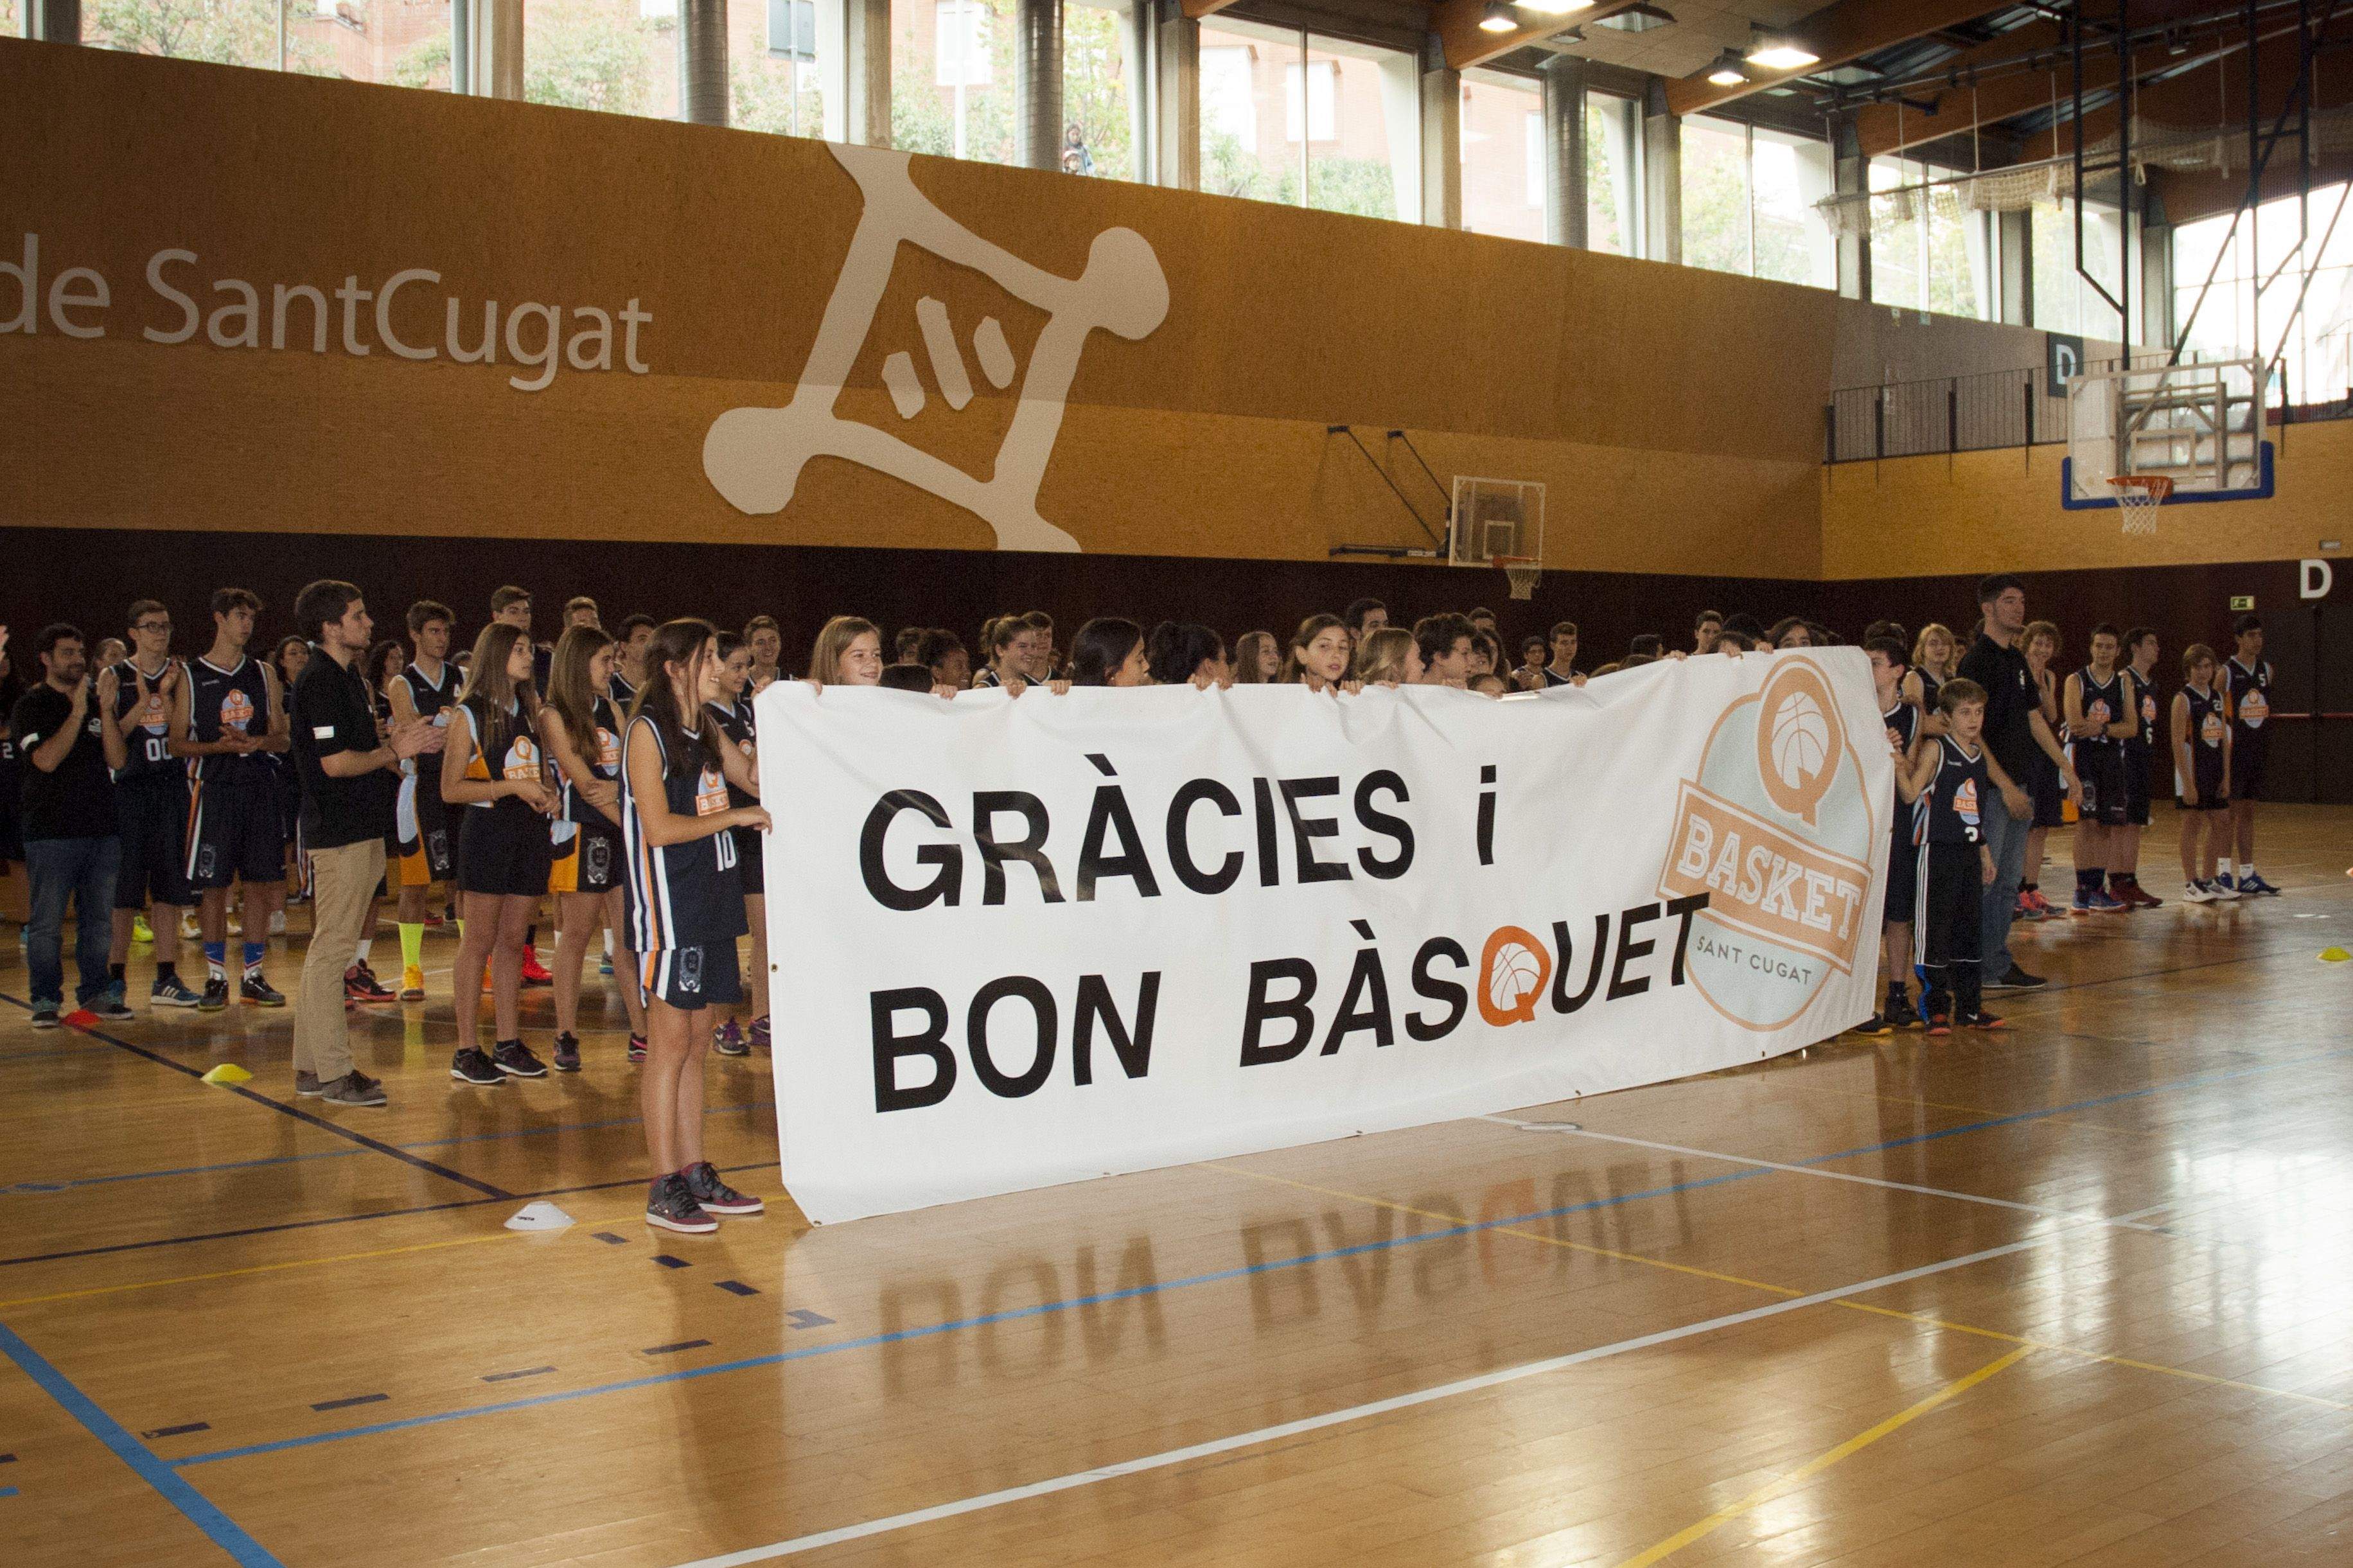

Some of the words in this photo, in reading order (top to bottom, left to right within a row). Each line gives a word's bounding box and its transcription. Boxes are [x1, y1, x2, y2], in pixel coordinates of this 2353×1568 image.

[145, 249, 653, 391] SantCugat
[2056, 344, 2076, 385] D
[2300, 559, 2332, 599] D
[714, 829, 737, 872] 10
[859, 753, 1415, 912] GRÀCIES
[1677, 813, 1862, 941] BASKET
[870, 971, 1161, 1113] BON
[1240, 891, 1711, 1067] BÀSQUET
[1696, 935, 1742, 963] SANT
[1749, 954, 1812, 985] CUGAT
